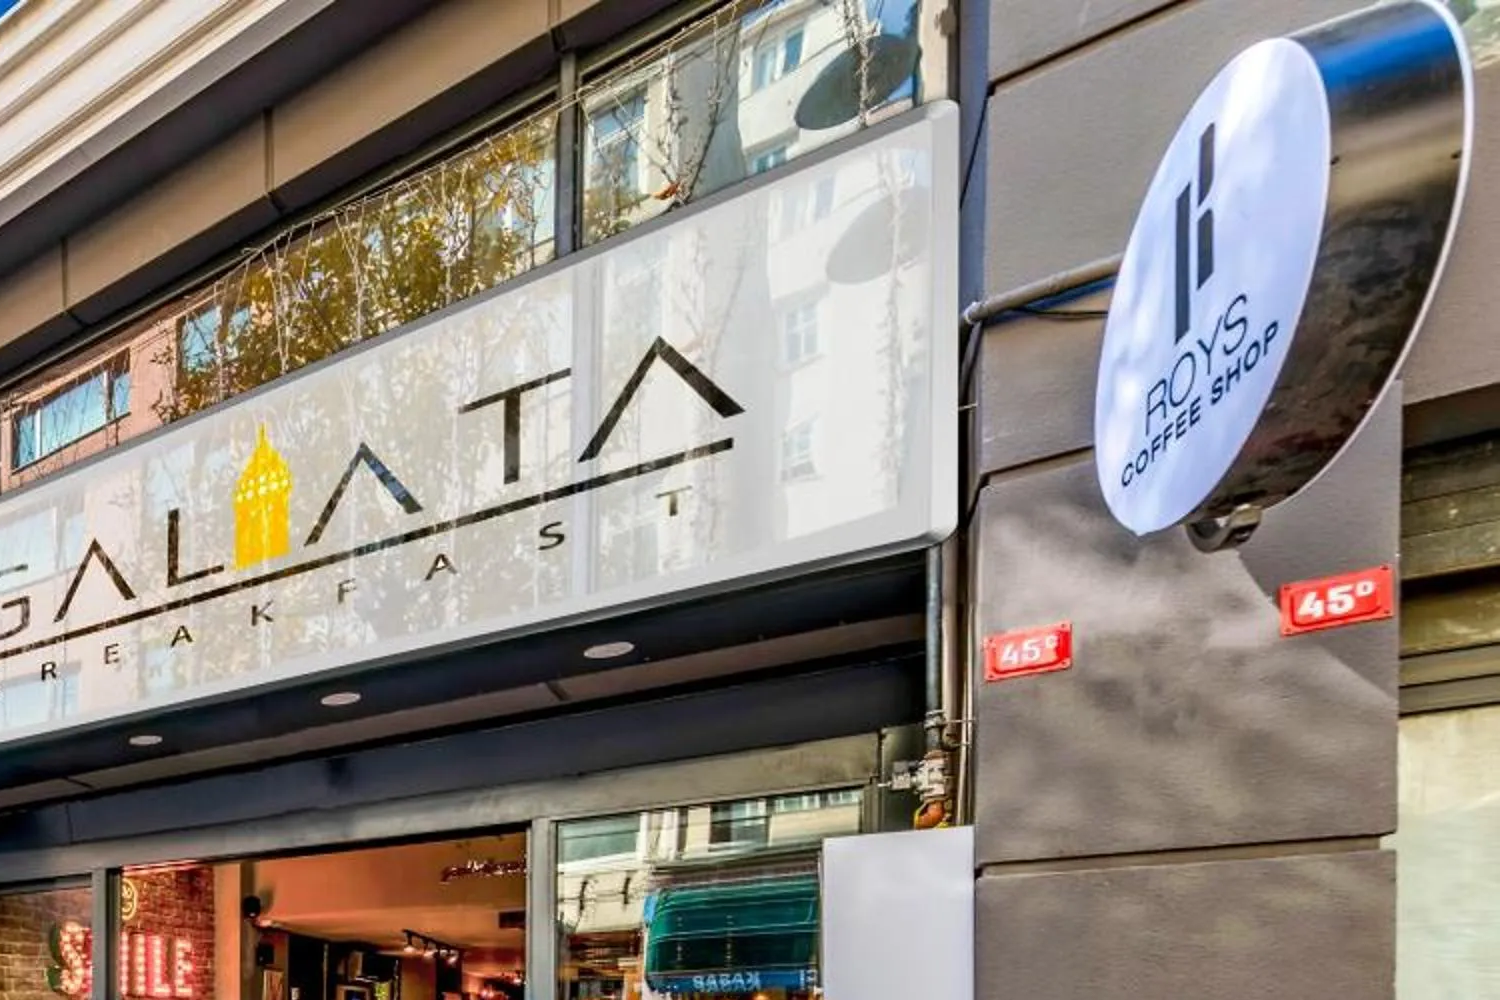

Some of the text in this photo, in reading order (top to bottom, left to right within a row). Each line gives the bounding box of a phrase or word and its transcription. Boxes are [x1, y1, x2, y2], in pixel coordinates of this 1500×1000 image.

[1121, 320, 1280, 488] COFFEE SHOP
[1146, 294, 1249, 436] ROYS
[59, 920, 195, 998] SILE
